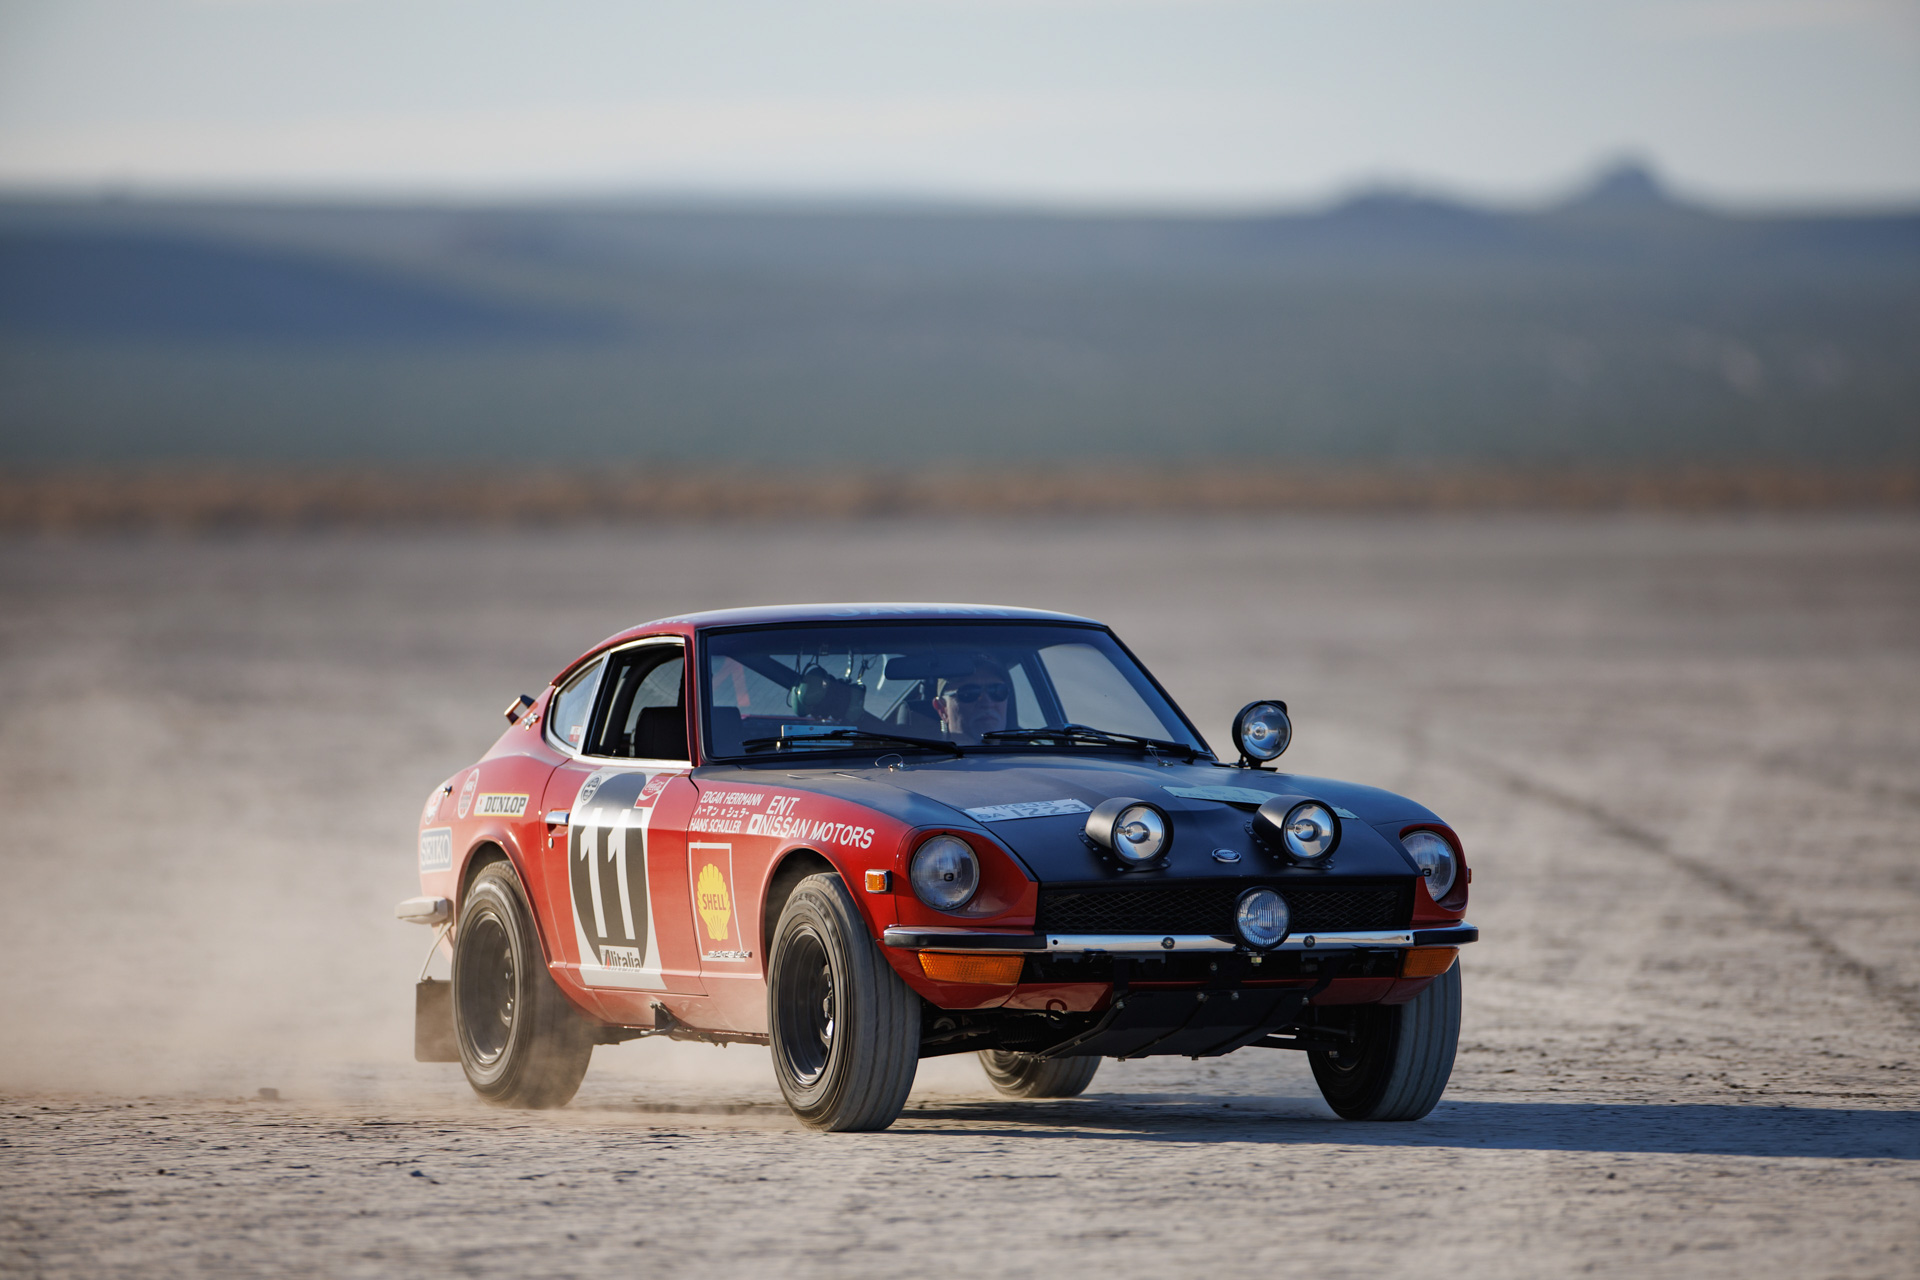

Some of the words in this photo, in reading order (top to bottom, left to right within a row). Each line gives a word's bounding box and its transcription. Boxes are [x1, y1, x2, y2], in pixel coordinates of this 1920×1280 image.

[484, 796, 527, 813] DUNLOP
[700, 791, 726, 804] EDGAR
[724, 792, 765, 807] HERRMANN
[766, 795, 801, 816] ENT.
[1010, 803, 1086, 817] 1223
[689, 818, 710, 832] HANS
[708, 819, 742, 834] SCHULLER
[758, 814, 812, 839] NISSAN
[809, 821, 875, 849] MOTORS
[420, 835, 451, 866] SEIKO
[579, 807, 636, 940] 11
[702, 893, 727, 911] SHELL
[604, 949, 641, 969] Alitalia
